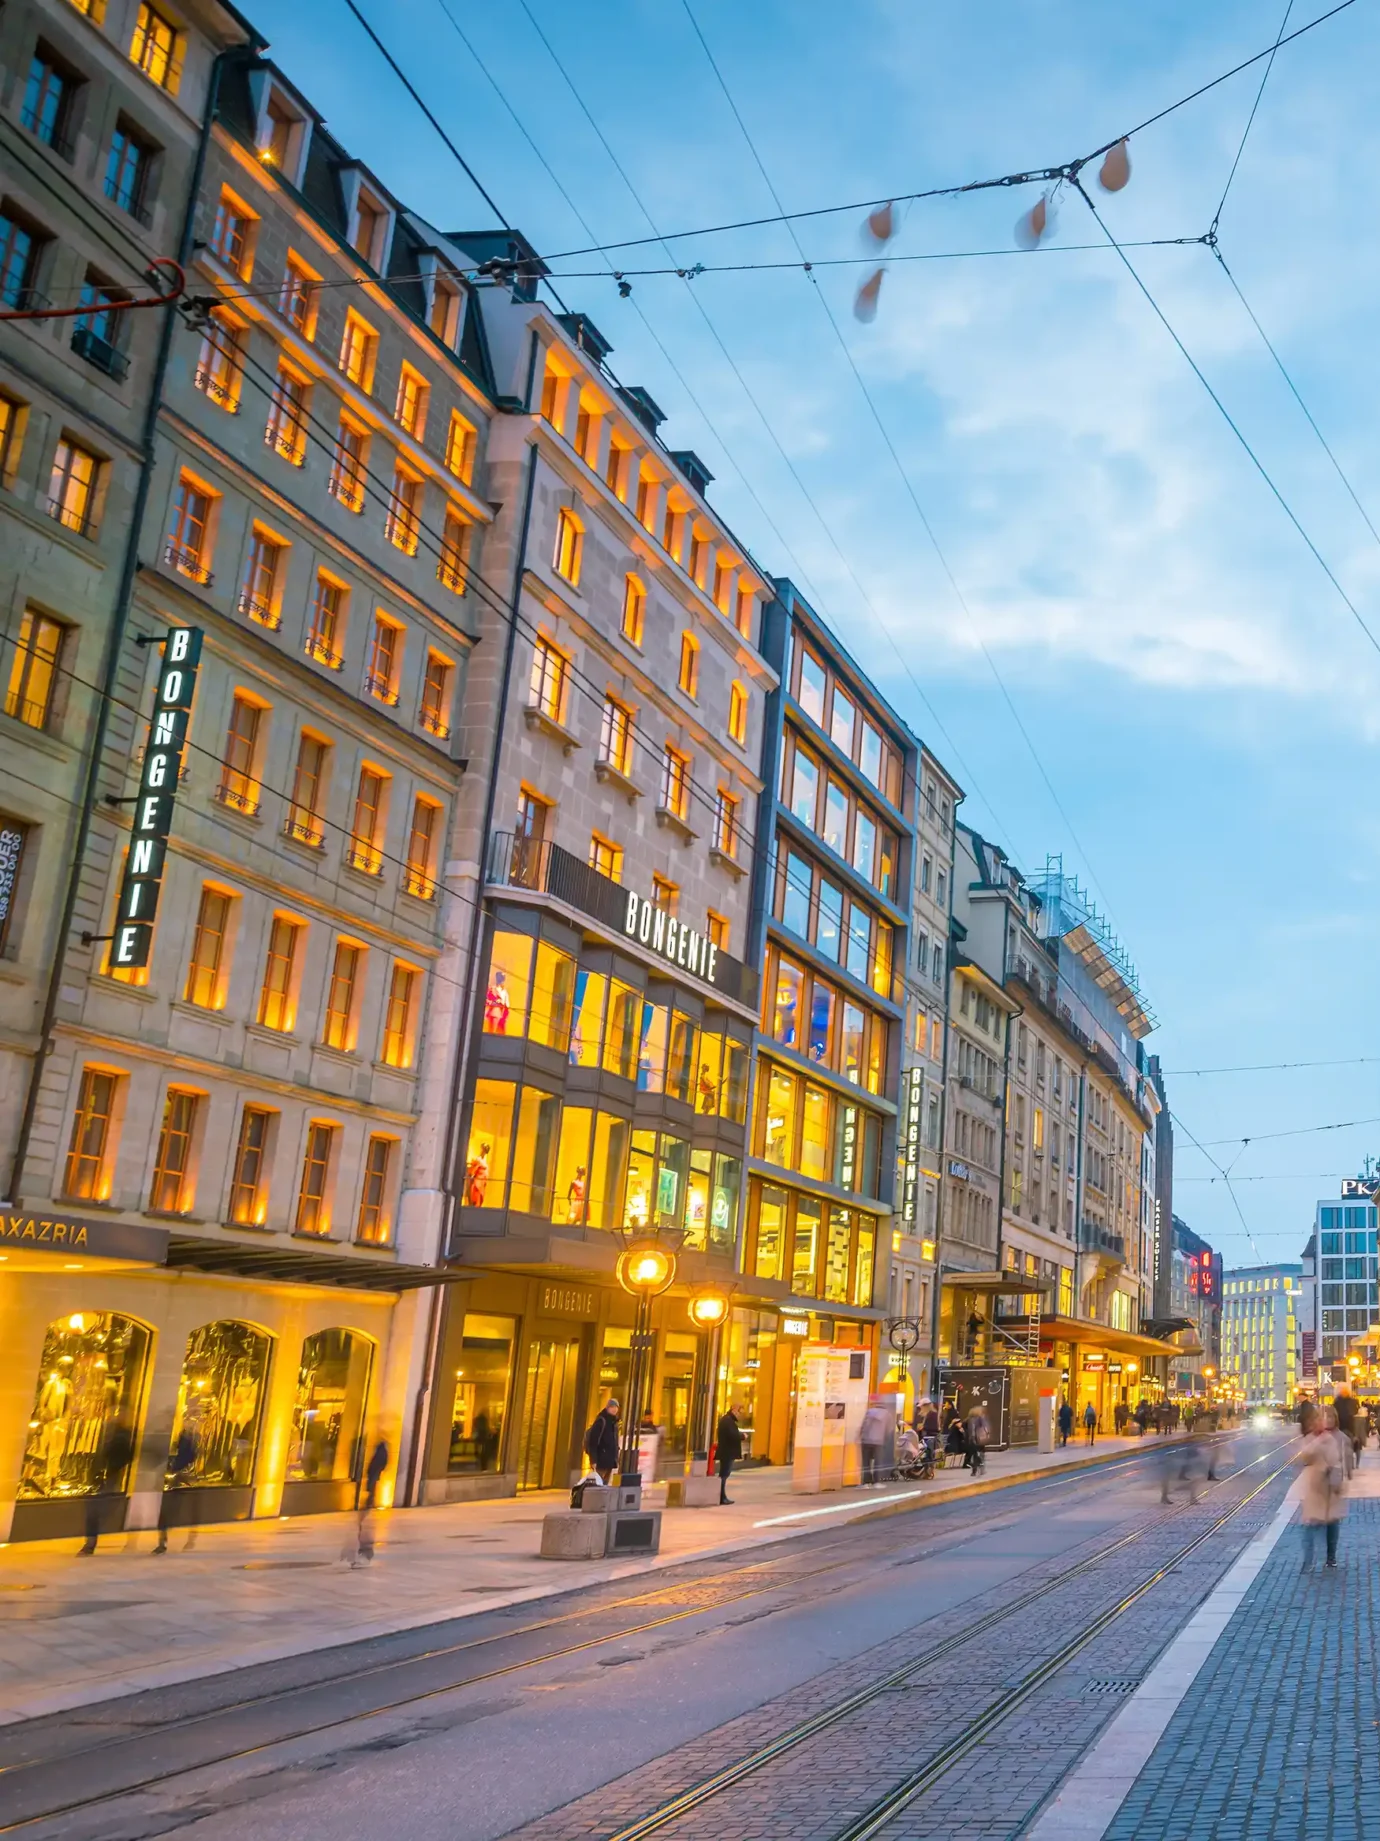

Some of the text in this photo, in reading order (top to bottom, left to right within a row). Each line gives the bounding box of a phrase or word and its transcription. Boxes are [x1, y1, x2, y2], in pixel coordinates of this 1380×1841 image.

[117, 629, 190, 963] BONGENIE
[0, 829, 15, 896] UER
[11, 834, 22, 852] 00
[626, 890, 718, 983] BONGENIE
[903, 1068, 922, 1222] BONGENIE
[544, 1288, 593, 1314] BONGENIE
